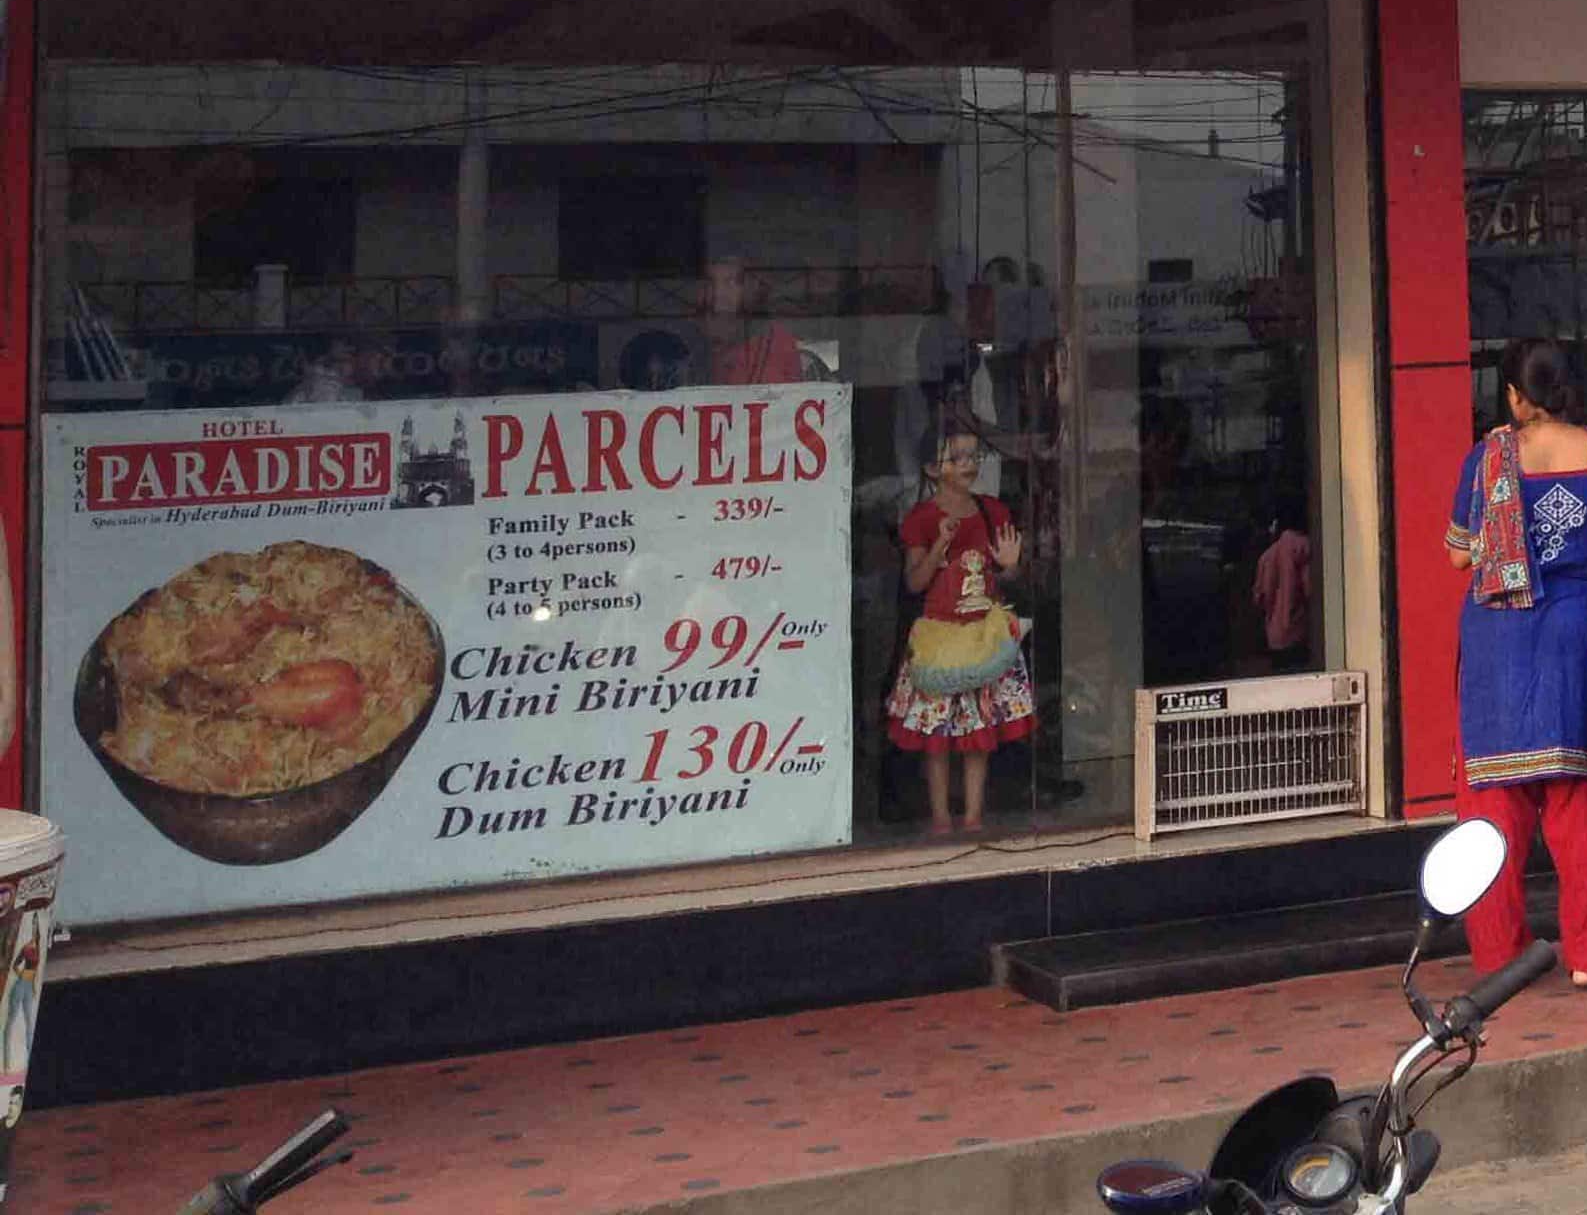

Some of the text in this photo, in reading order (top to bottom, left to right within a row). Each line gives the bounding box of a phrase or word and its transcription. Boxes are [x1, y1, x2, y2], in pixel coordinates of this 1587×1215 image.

[203, 420, 284, 438] HOTEL
[481, 398, 828, 498] PARCELS
[73, 446, 86, 514] ROYAL
[98, 441, 382, 503] PARADISE
[165, 504, 261, 525] Hyderabad
[267, 497, 386, 519] Dum-Biriyani
[488, 514, 570, 536] Family
[578, 510, 635, 531] Pack
[713, 496, 785, 522] 339/-
[486, 542, 507, 564] (3
[514, 543, 533, 559] to
[488, 577, 553, 598] Party
[562, 571, 618, 590] Pack
[711, 555, 783, 581] 479/-
[486, 599, 507, 621] (4
[514, 599, 533, 616] to
[557, 592, 643, 617] persons)
[450, 611, 805, 680] Chicken 99/-
[781, 619, 829, 640] Only
[446, 667, 762, 723] Mini Biriyani
[1161, 692, 1222, 709] Time
[437, 716, 826, 796] Chicken 130/-
[779, 756, 827, 776] Only
[434, 778, 752, 840] Dum Biriyani
